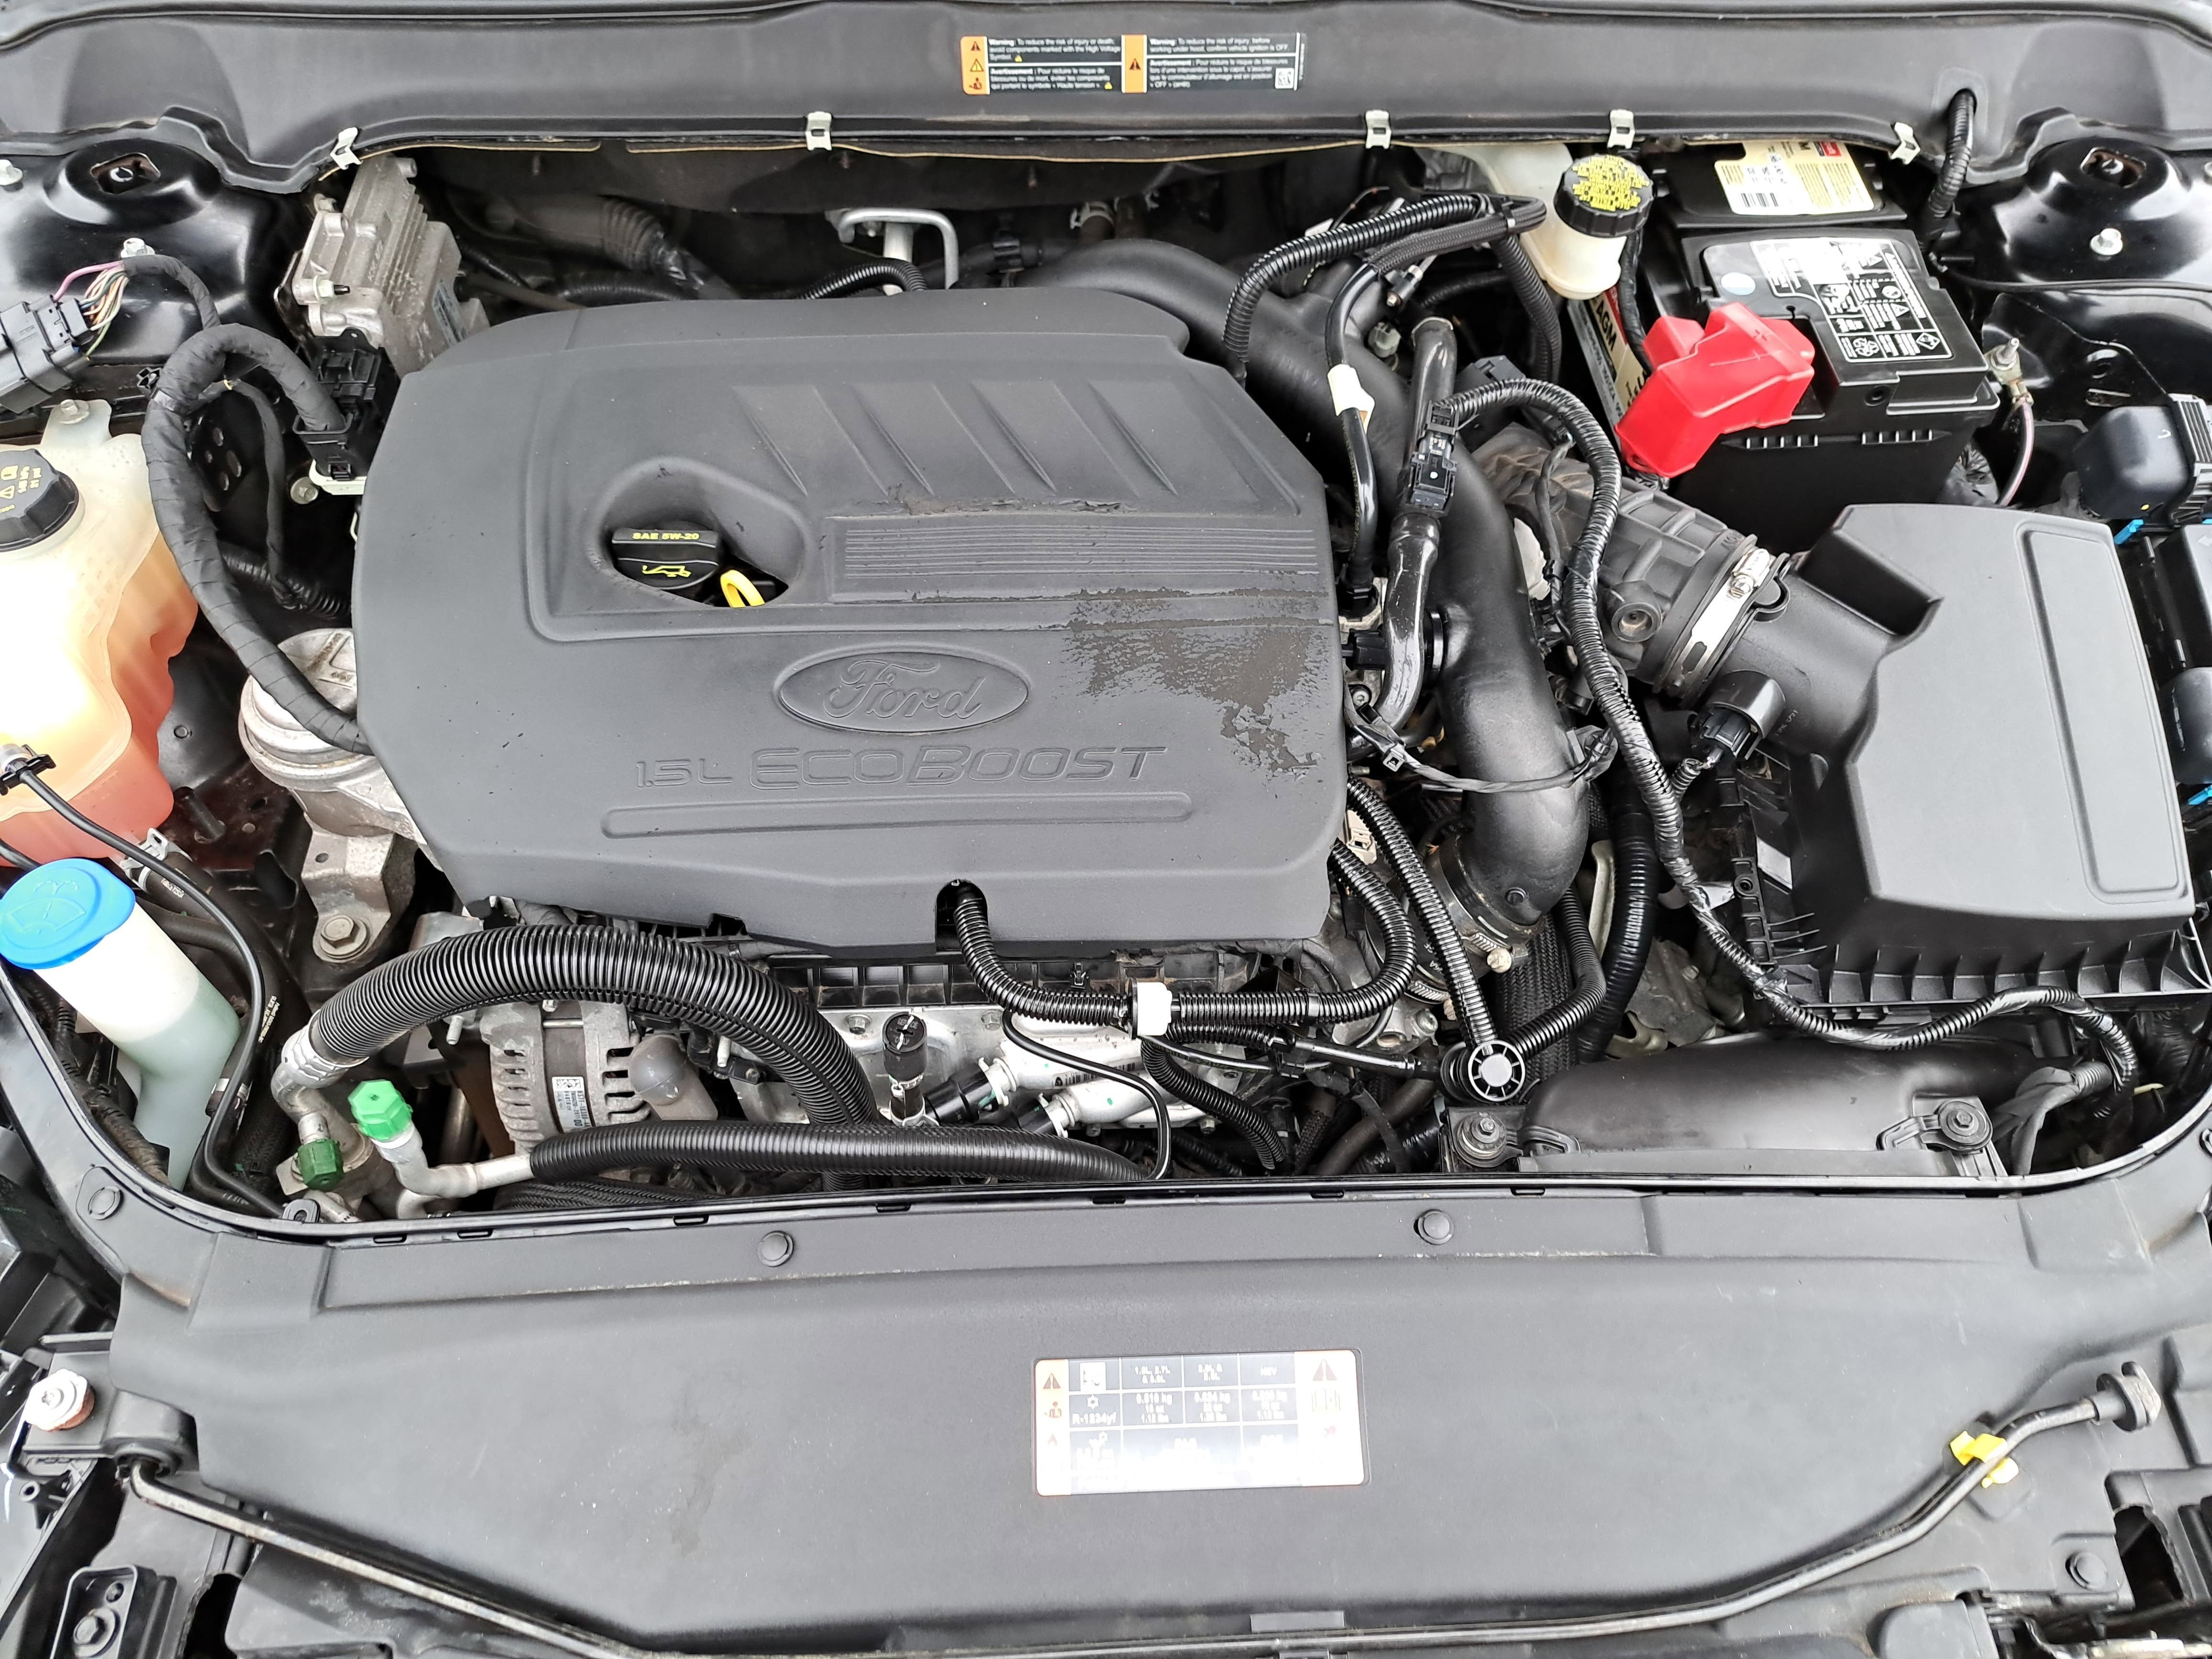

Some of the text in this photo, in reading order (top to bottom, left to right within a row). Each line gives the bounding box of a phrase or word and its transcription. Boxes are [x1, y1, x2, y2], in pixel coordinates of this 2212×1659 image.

[1596, 299, 1617, 351] AGM
[661, 532, 700, 541] 5W-20
[823, 658, 986, 719] Ford
[635, 758, 732, 789] 1.5L
[1072, 1412, 1117, 1426] R-1234yf
